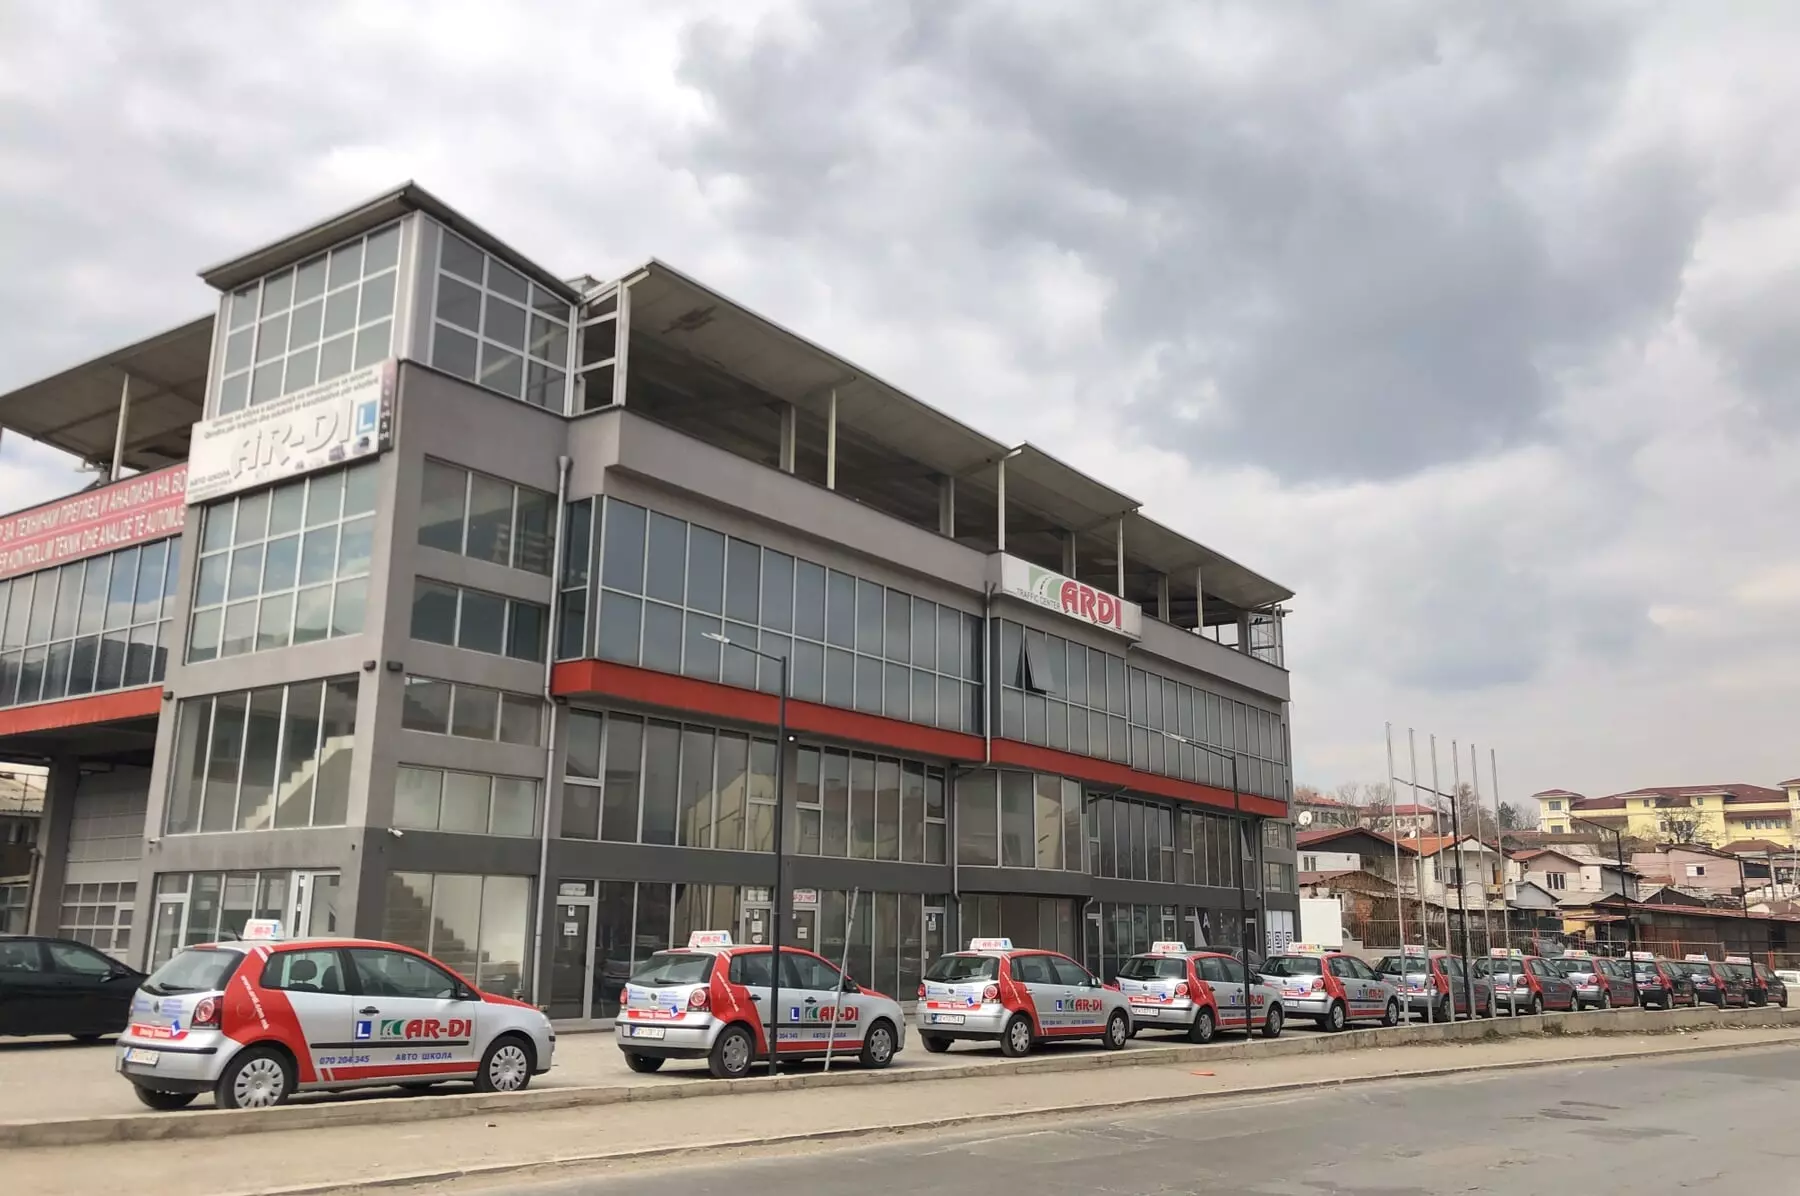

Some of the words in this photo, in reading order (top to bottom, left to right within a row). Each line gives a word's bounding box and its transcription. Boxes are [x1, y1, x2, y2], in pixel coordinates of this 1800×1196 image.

[231, 399, 353, 479] AR-DI
[1016, 587, 1038, 603] TRAFFIC
[1039, 595, 1061, 610] CENTER
[1061, 580, 1122, 629] ARDI
[1075, 998, 1103, 1012] AR-DI
[1248, 994, 1265, 1005] R-DI
[791, 1007, 799, 1020] L
[357, 1023, 369, 1038] L
[405, 1019, 472, 1040] AR-DI
[319, 1056, 336, 1064] 070
[395, 1053, 418, 1061] АВТО
[421, 1051, 453, 1061] ШКОЛА
